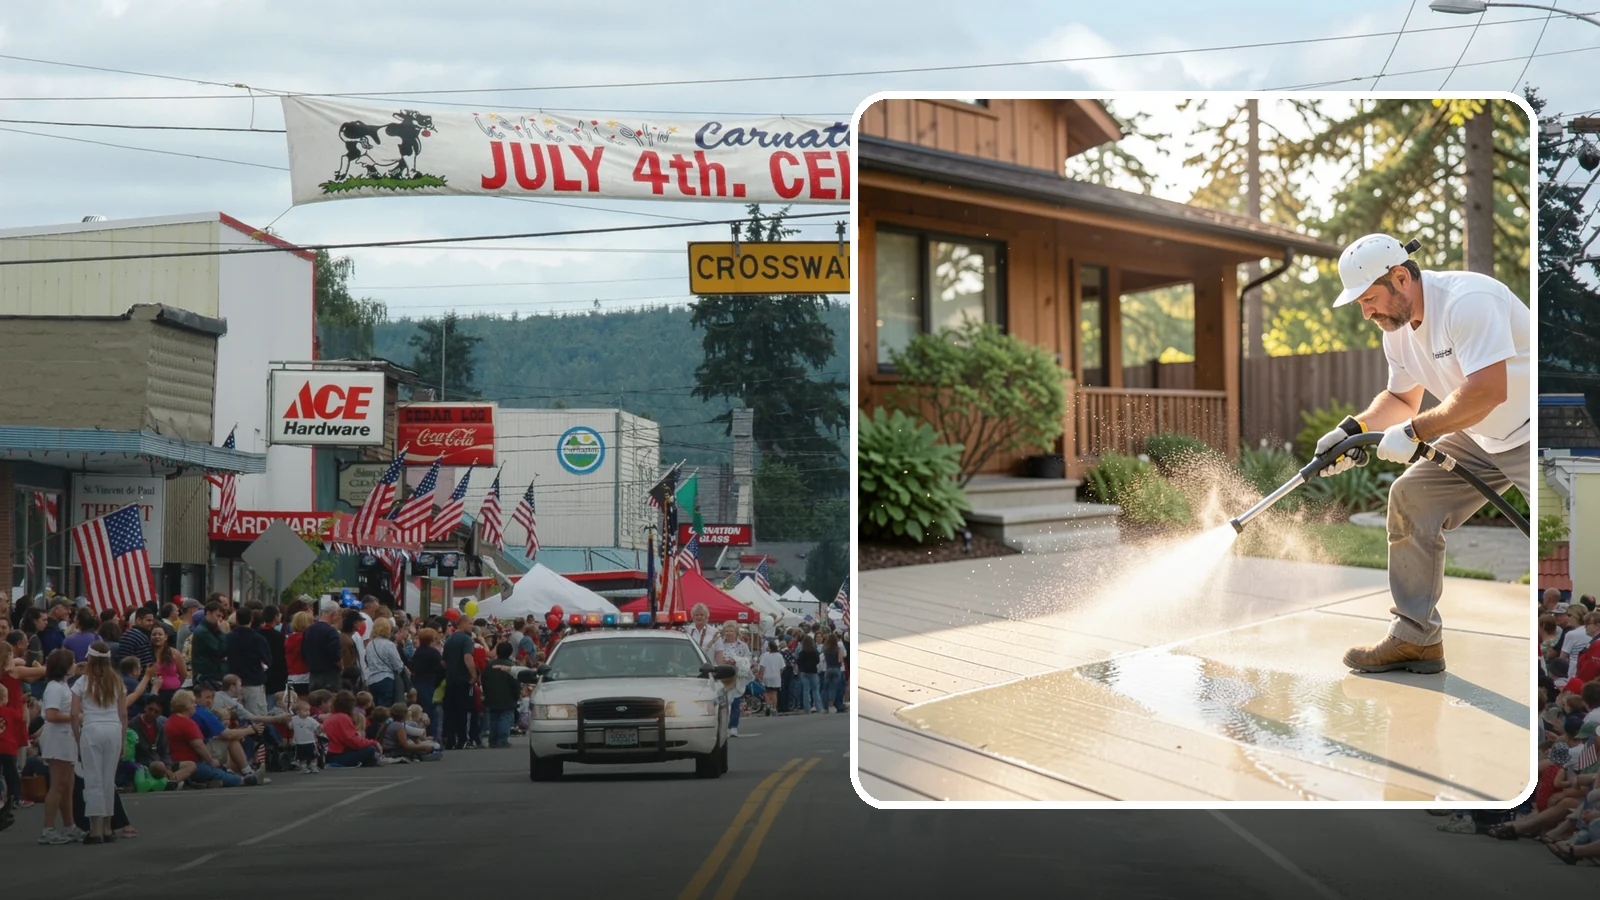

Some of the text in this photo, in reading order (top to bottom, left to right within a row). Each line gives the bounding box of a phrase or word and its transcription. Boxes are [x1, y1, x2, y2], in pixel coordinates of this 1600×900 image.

[481, 141, 605, 192] JULY
[632, 150, 747, 197] 4th.
[697, 254, 850, 280] CROSSWA
[283, 380, 373, 420] ACE
[406, 409, 485, 421] CEDAR LOG
[284, 421, 370, 436] Hardware
[416, 428, 477, 447] Coca-Cola
[353, 467, 384, 479] Simpl
[95, 485, 124, 494] Vincent
[126, 486, 136, 494] de
[137, 486, 155, 495] Paul
[688, 526, 742, 535] CRNATION
[699, 535, 730, 543] GLASS
